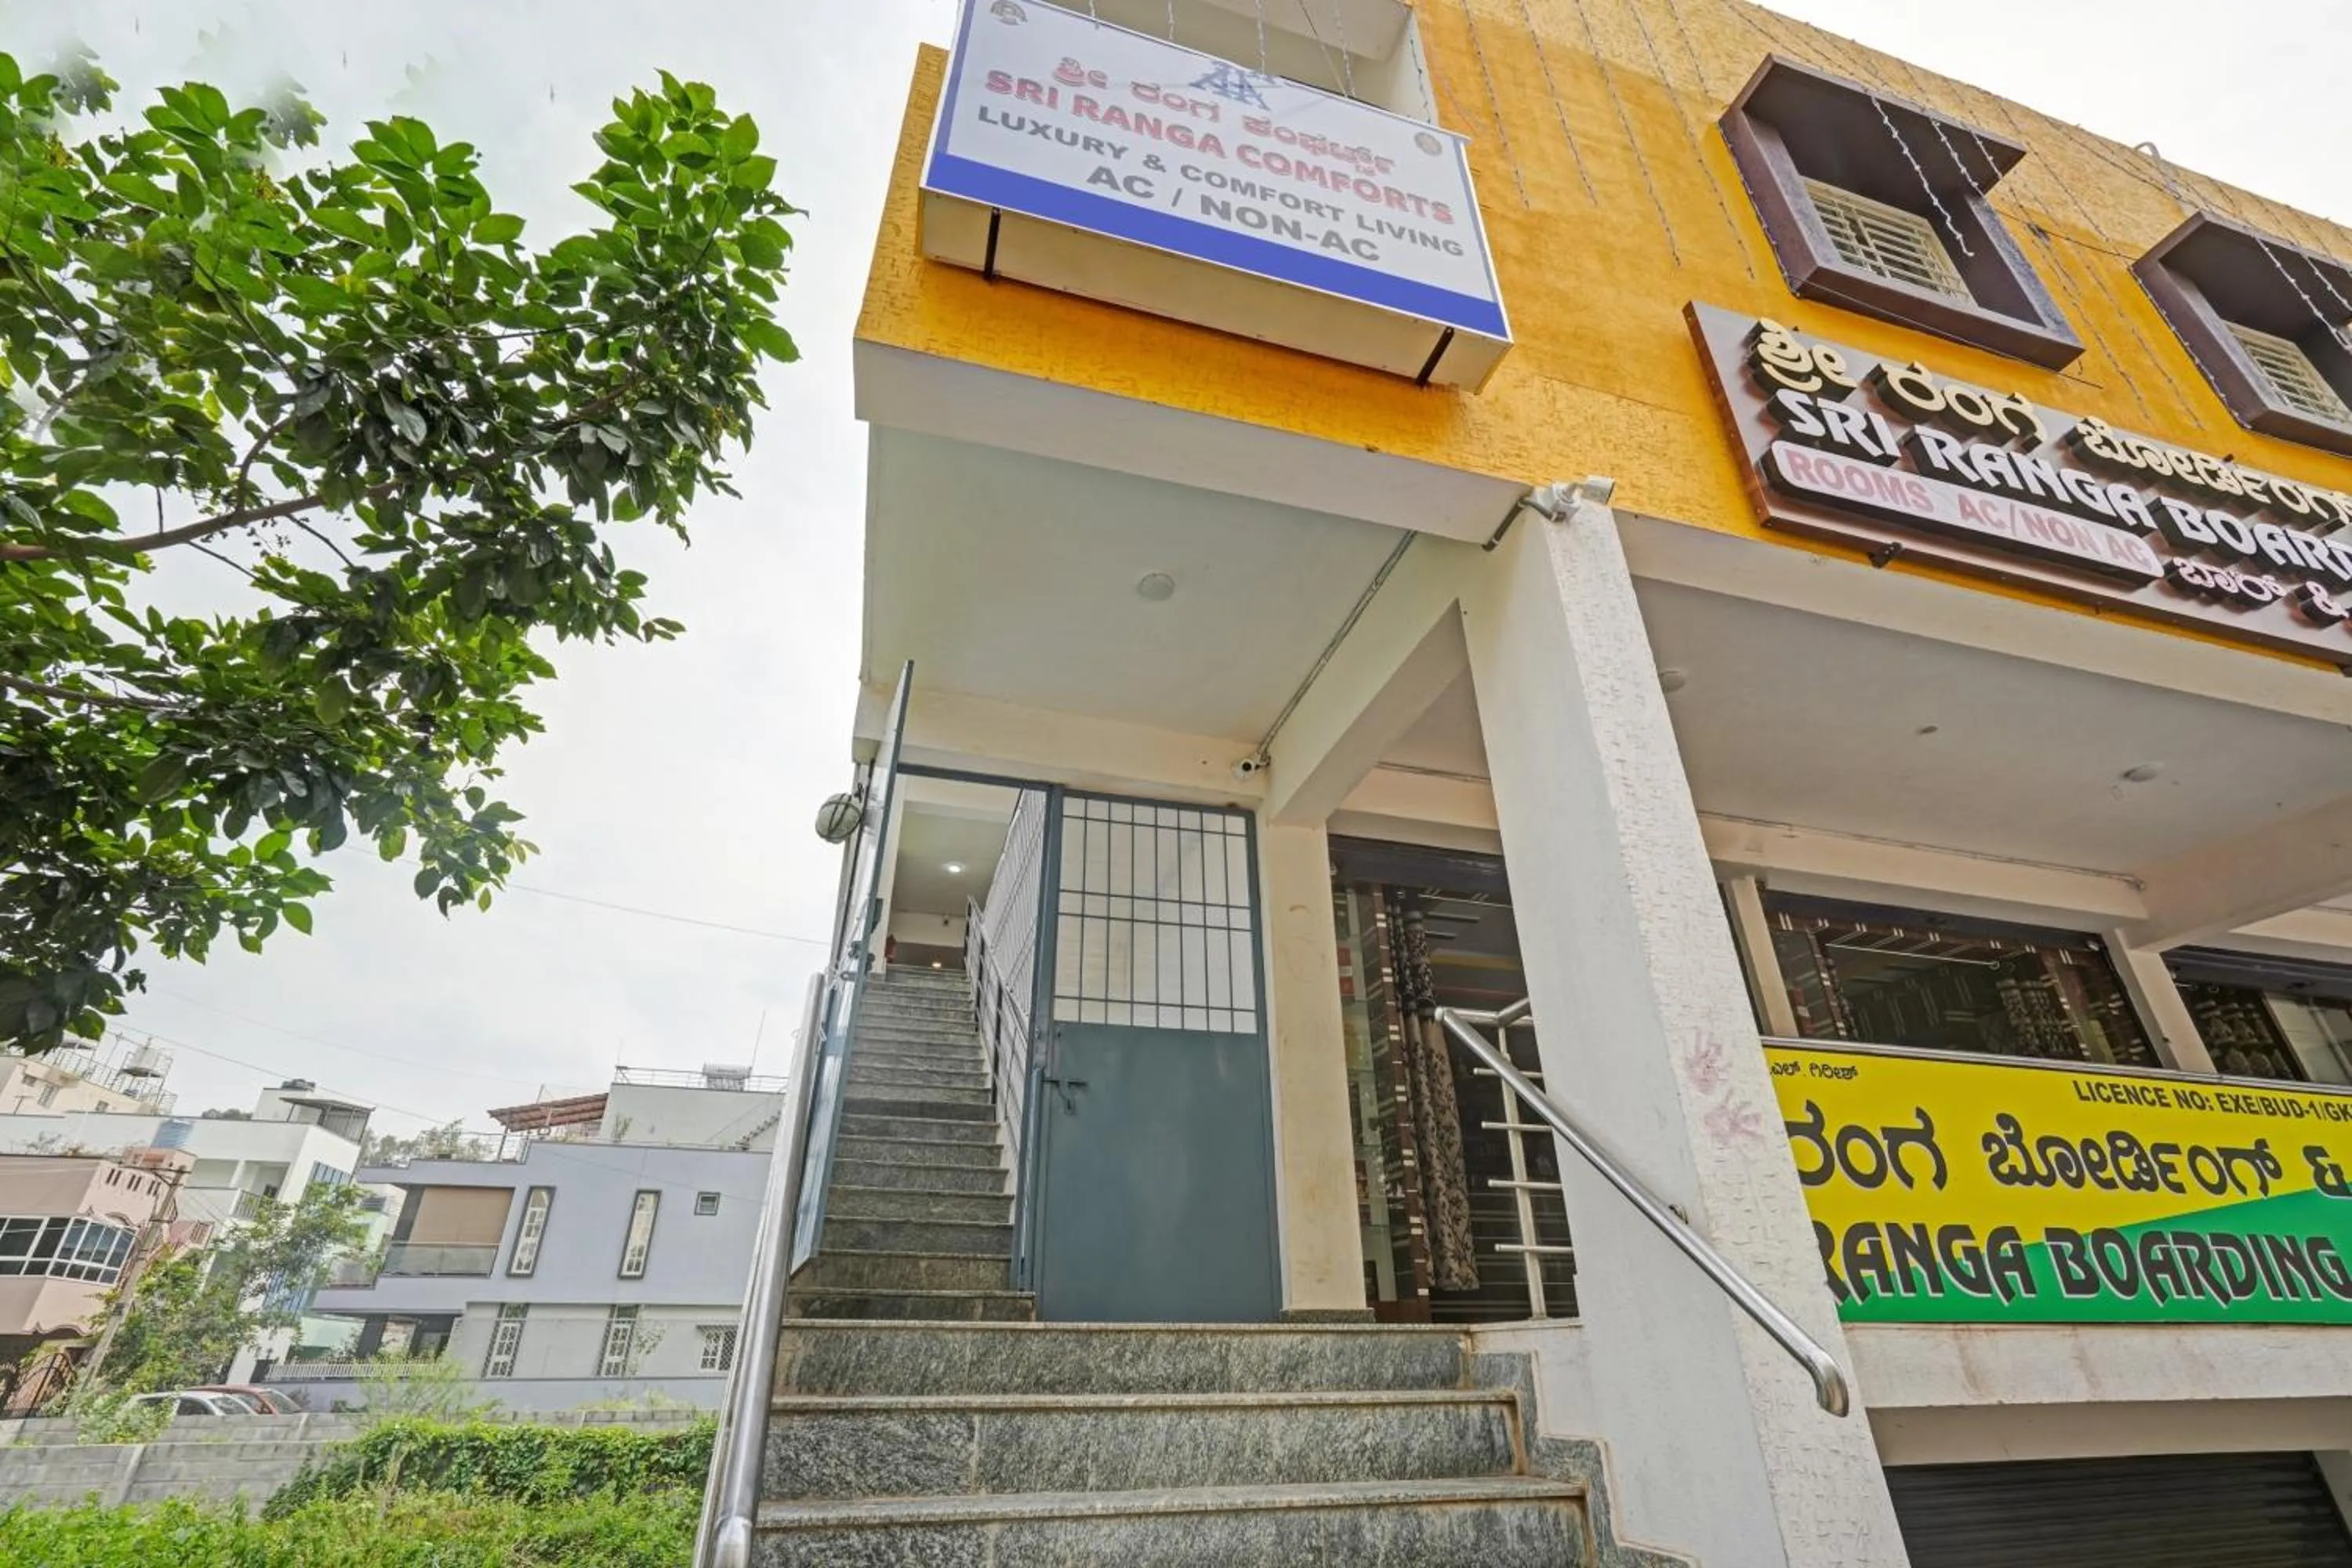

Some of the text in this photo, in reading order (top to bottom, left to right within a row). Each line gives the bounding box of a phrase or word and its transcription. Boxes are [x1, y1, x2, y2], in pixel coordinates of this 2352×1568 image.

[978, 105, 1464, 257] LUXURY & COMFORT LIVING
[985, 70, 1454, 225] SRI RANGA COMFORTS
[1087, 165, 1380, 262] AC / NON-AC
[1879, 361, 2048, 446] ರಂಗ
[1775, 388, 1901, 457] SRI
[1914, 424, 2158, 529] RANGA
[1784, 448, 2154, 571] ROOMS AC/NON AC
[2306, 581, 2350, 618] &
[2073, 1080, 2172, 1109] LICENCE
[2172, 1088, 2215, 1112] NO:
[2302, 1145, 2352, 1197] &
[2044, 1226, 2352, 1309] BOARDING
